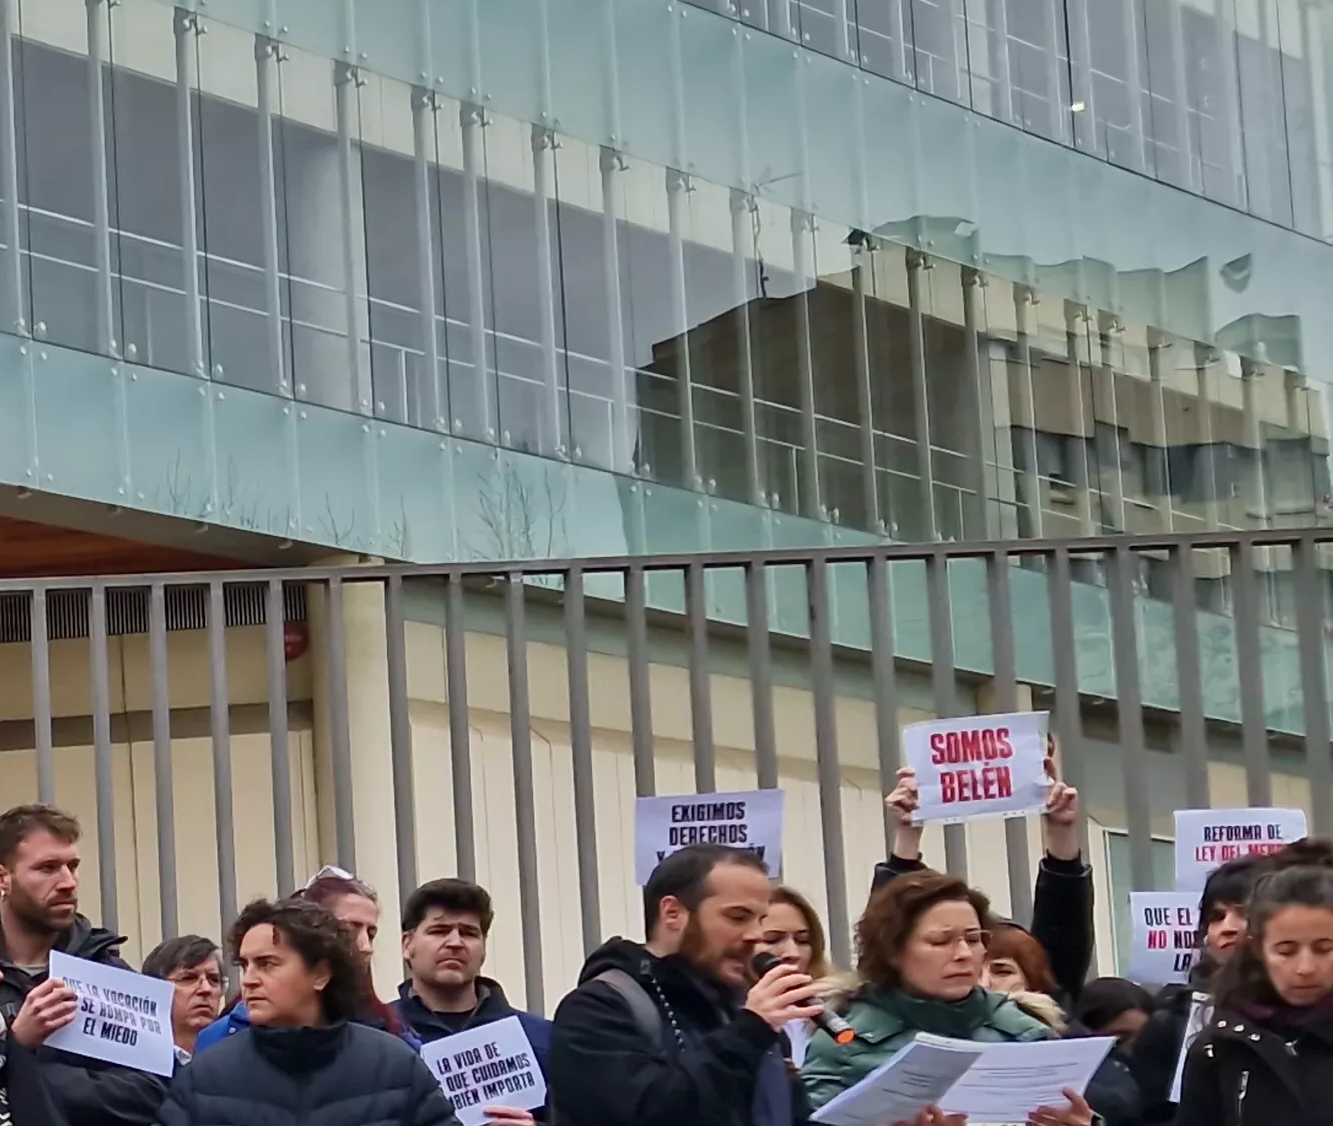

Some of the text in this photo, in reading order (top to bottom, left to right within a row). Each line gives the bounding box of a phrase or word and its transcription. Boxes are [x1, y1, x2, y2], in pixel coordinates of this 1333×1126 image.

[930, 728, 1014, 765] SOMOS
[940, 761, 1013, 803] BELÉN
[671, 801, 746, 823] EXIGIMOS
[669, 824, 748, 846] DERECHOS
[1204, 824, 1282, 841] REFORMA DE
[1196, 846, 1215, 861] LEY
[1144, 907, 1193, 927] QUE EL
[1148, 929, 1167, 949] NO
[102, 988, 158, 1017] VOCACIÓN
[100, 1021, 138, 1046] MIEDO
[436, 1041, 501, 1075] LA VIDA DE
[445, 1053, 531, 1092] QUE CUIDAMOS
[483, 1071, 536, 1101] IMPORTA
